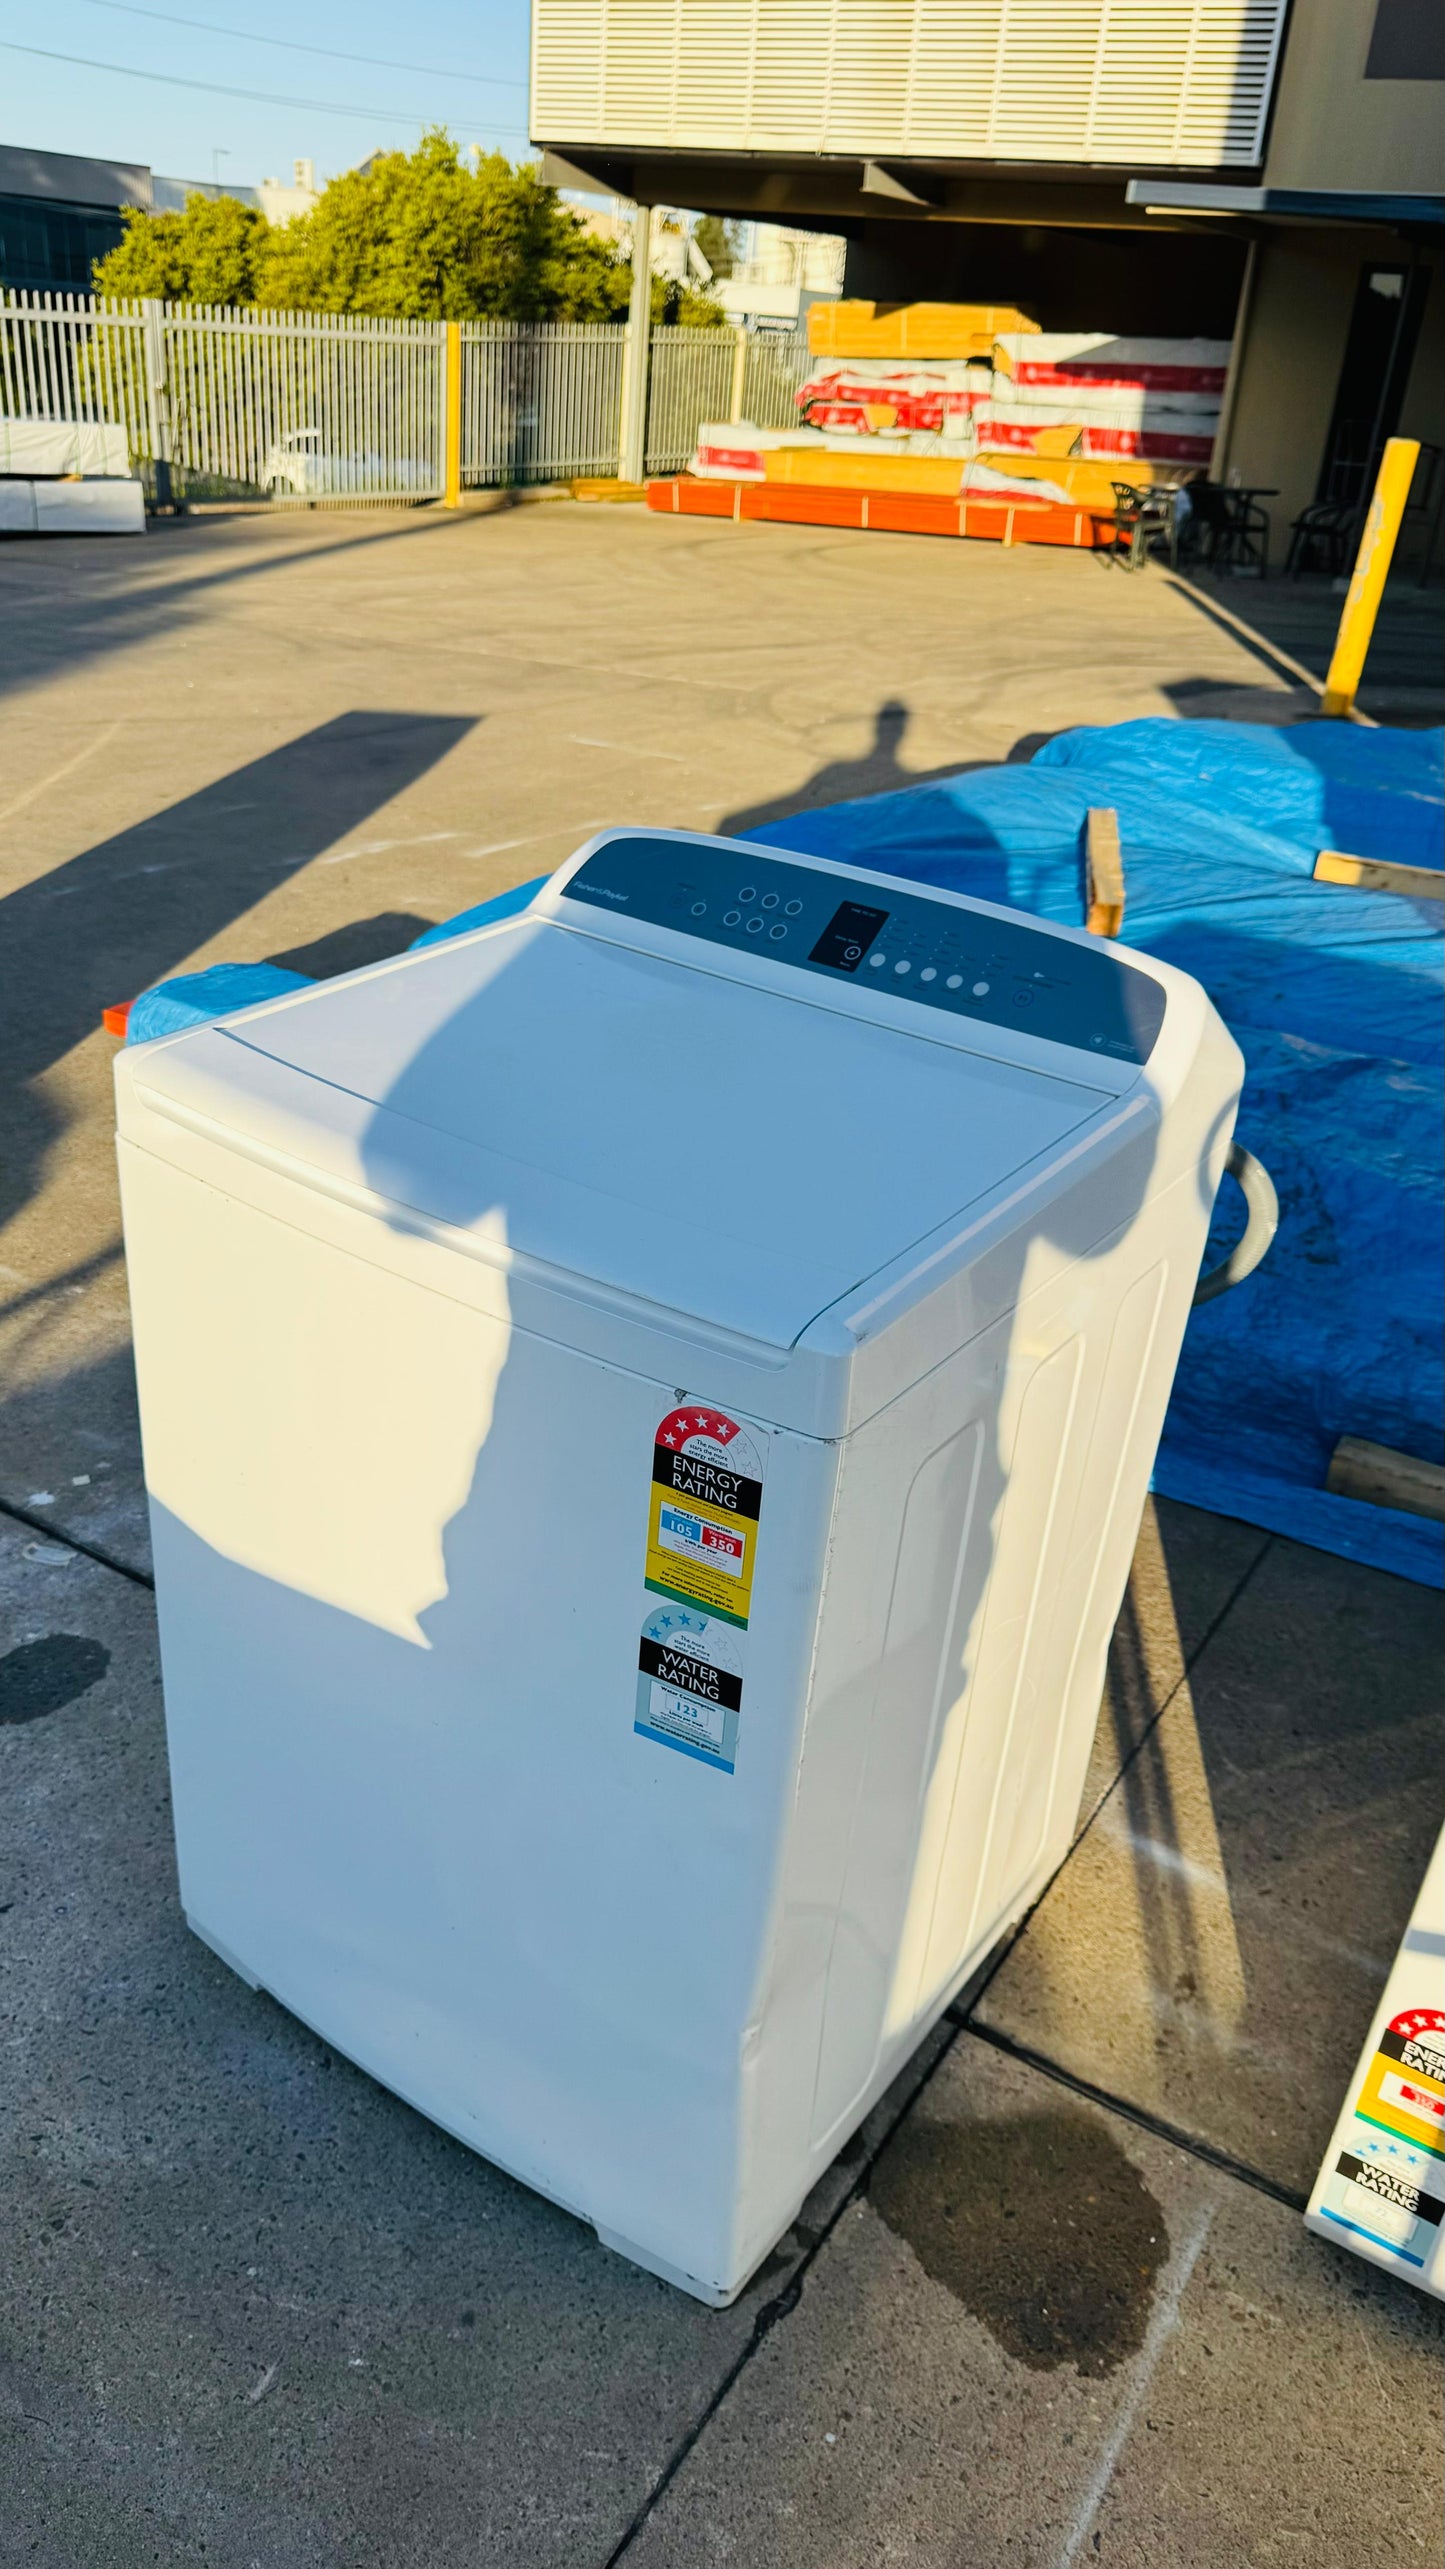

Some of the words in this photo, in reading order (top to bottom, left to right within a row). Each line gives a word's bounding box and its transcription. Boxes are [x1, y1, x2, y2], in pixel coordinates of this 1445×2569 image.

[688, 1450, 705, 1460] energy
[707, 1456, 728, 1467] efficient
[689, 1443, 702, 1451] stars
[713, 1453, 727, 1461] more
[708, 1444, 722, 1452] more
[673, 1455, 742, 1492] ENERGY
[672, 1472, 737, 1509] RATING
[669, 1520, 693, 1538] 105
[673, 1507, 692, 1519] Energy
[694, 1515, 732, 1534] Consumption
[709, 1536, 735, 1554] 350
[659, 1576, 734, 1610] www.energyrating.gov.au
[662, 1649, 719, 1685] WATER
[657, 1663, 720, 1700] RATING
[660, 1686, 677, 1695] Water
[679, 1694, 715, 1712] Consumption
[676, 1702, 698, 1718] 123
[1355, 2171, 1419, 2212] RATING
[1362, 2162, 1420, 2202] WATER
